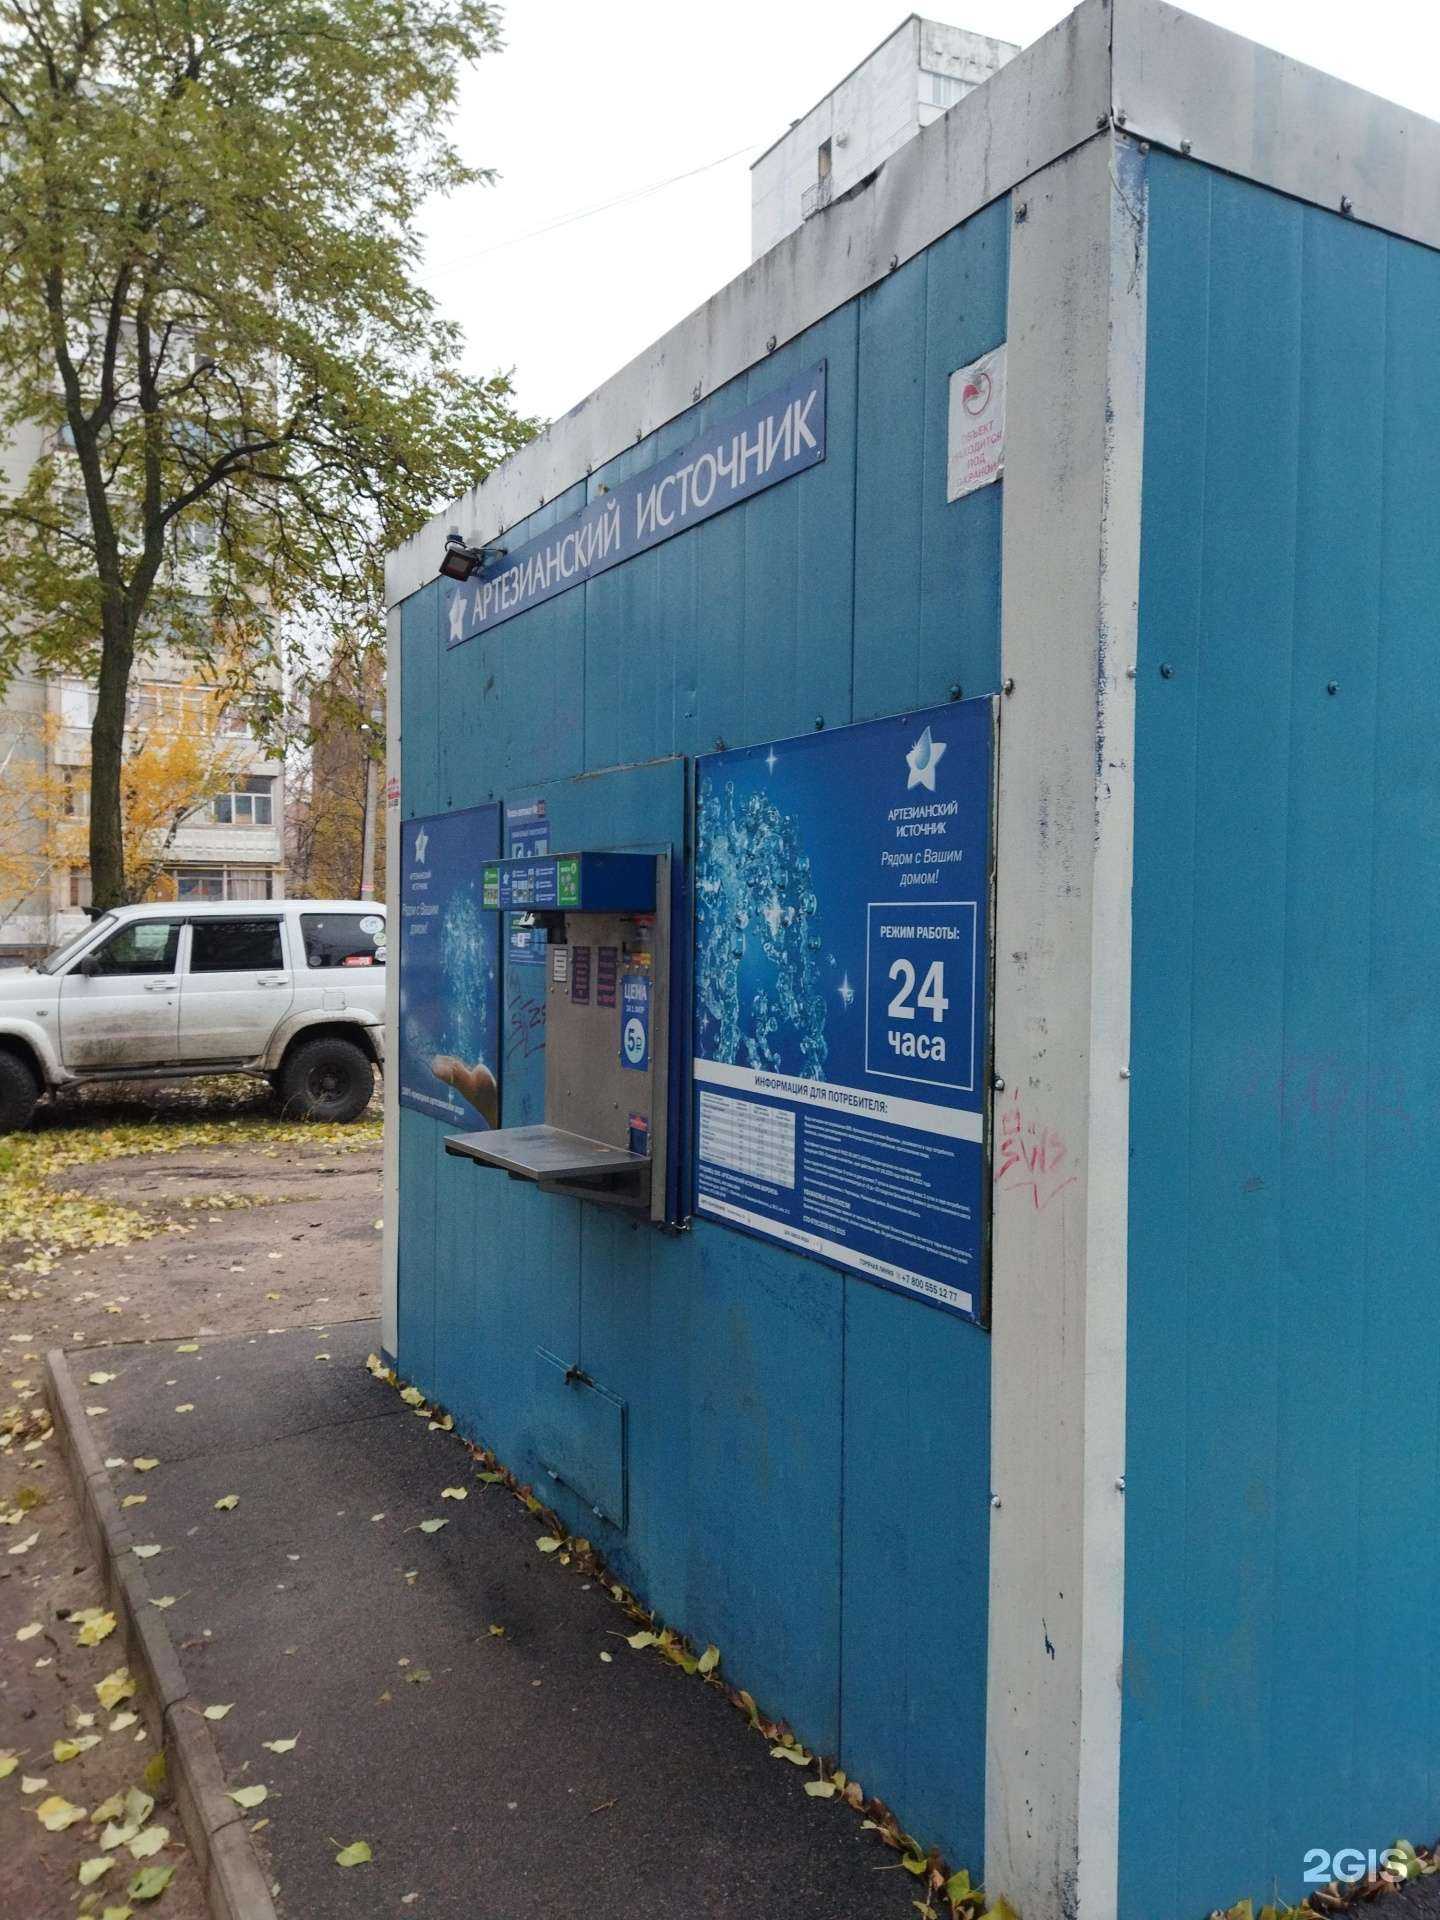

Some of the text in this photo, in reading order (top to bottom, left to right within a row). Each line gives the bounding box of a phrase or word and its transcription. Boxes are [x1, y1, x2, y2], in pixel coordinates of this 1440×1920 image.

[471, 390, 817, 625] АРТЕЗИАНСКИЙ ИСТОЧНИК
[888, 800, 959, 821] АРТЕЗИАНСКИЙ
[896, 822, 947, 838] ИСТОЧНИК
[881, 848, 963, 868] Рядом с Вашим
[899, 869, 940, 887] домом!
[880, 925, 960, 940] РЕЖИМ РАБОТЫ:
[624, 984, 648, 1003] ЦЕНА
[888, 958, 949, 1023] 24
[888, 1030, 946, 1062] часа
[754, 1075, 888, 1113] ИНФОРМАЦИЯ ДЛЯ ПОТРЕБИТЕЛЯ:
